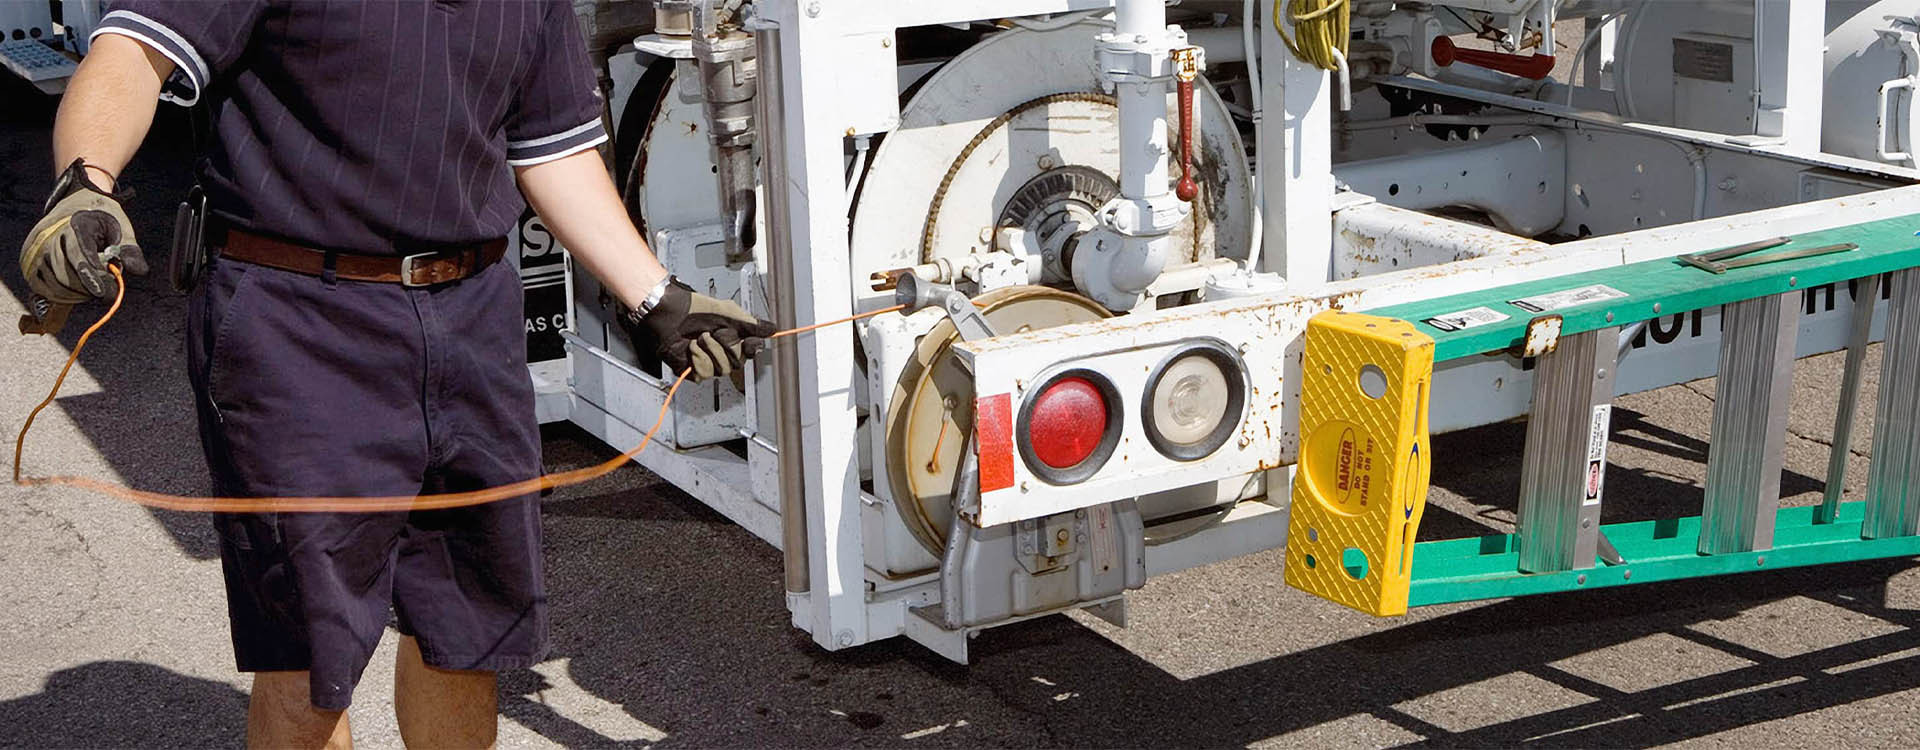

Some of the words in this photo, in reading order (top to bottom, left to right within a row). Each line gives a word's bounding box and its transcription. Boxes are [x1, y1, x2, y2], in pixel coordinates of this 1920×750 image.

[1366, 438, 1374, 453] SIT
[1338, 440, 1353, 491] DANGER
[1364, 457, 1371, 471] OR
[1354, 475, 1361, 489] DO
[1360, 474, 1370, 506] STAND
